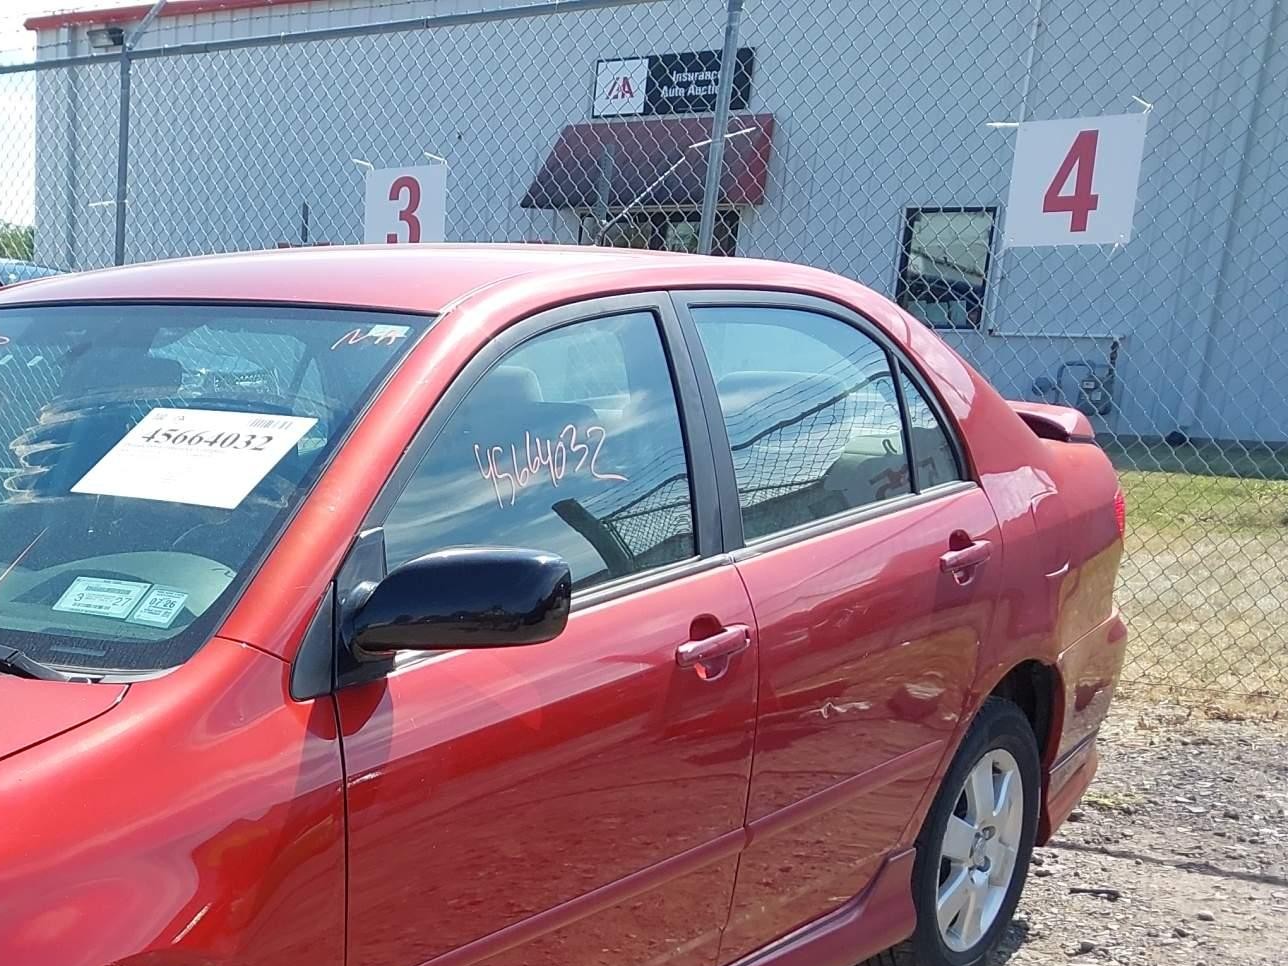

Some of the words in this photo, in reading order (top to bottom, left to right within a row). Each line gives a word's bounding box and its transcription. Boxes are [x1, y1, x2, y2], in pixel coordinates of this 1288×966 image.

[661, 85, 685, 98] Auto
[386, 175, 421, 244] 3
[1042, 129, 1100, 233] 4
[142, 427, 274, 452] 45664032
[473, 423, 630, 510] 45664032
